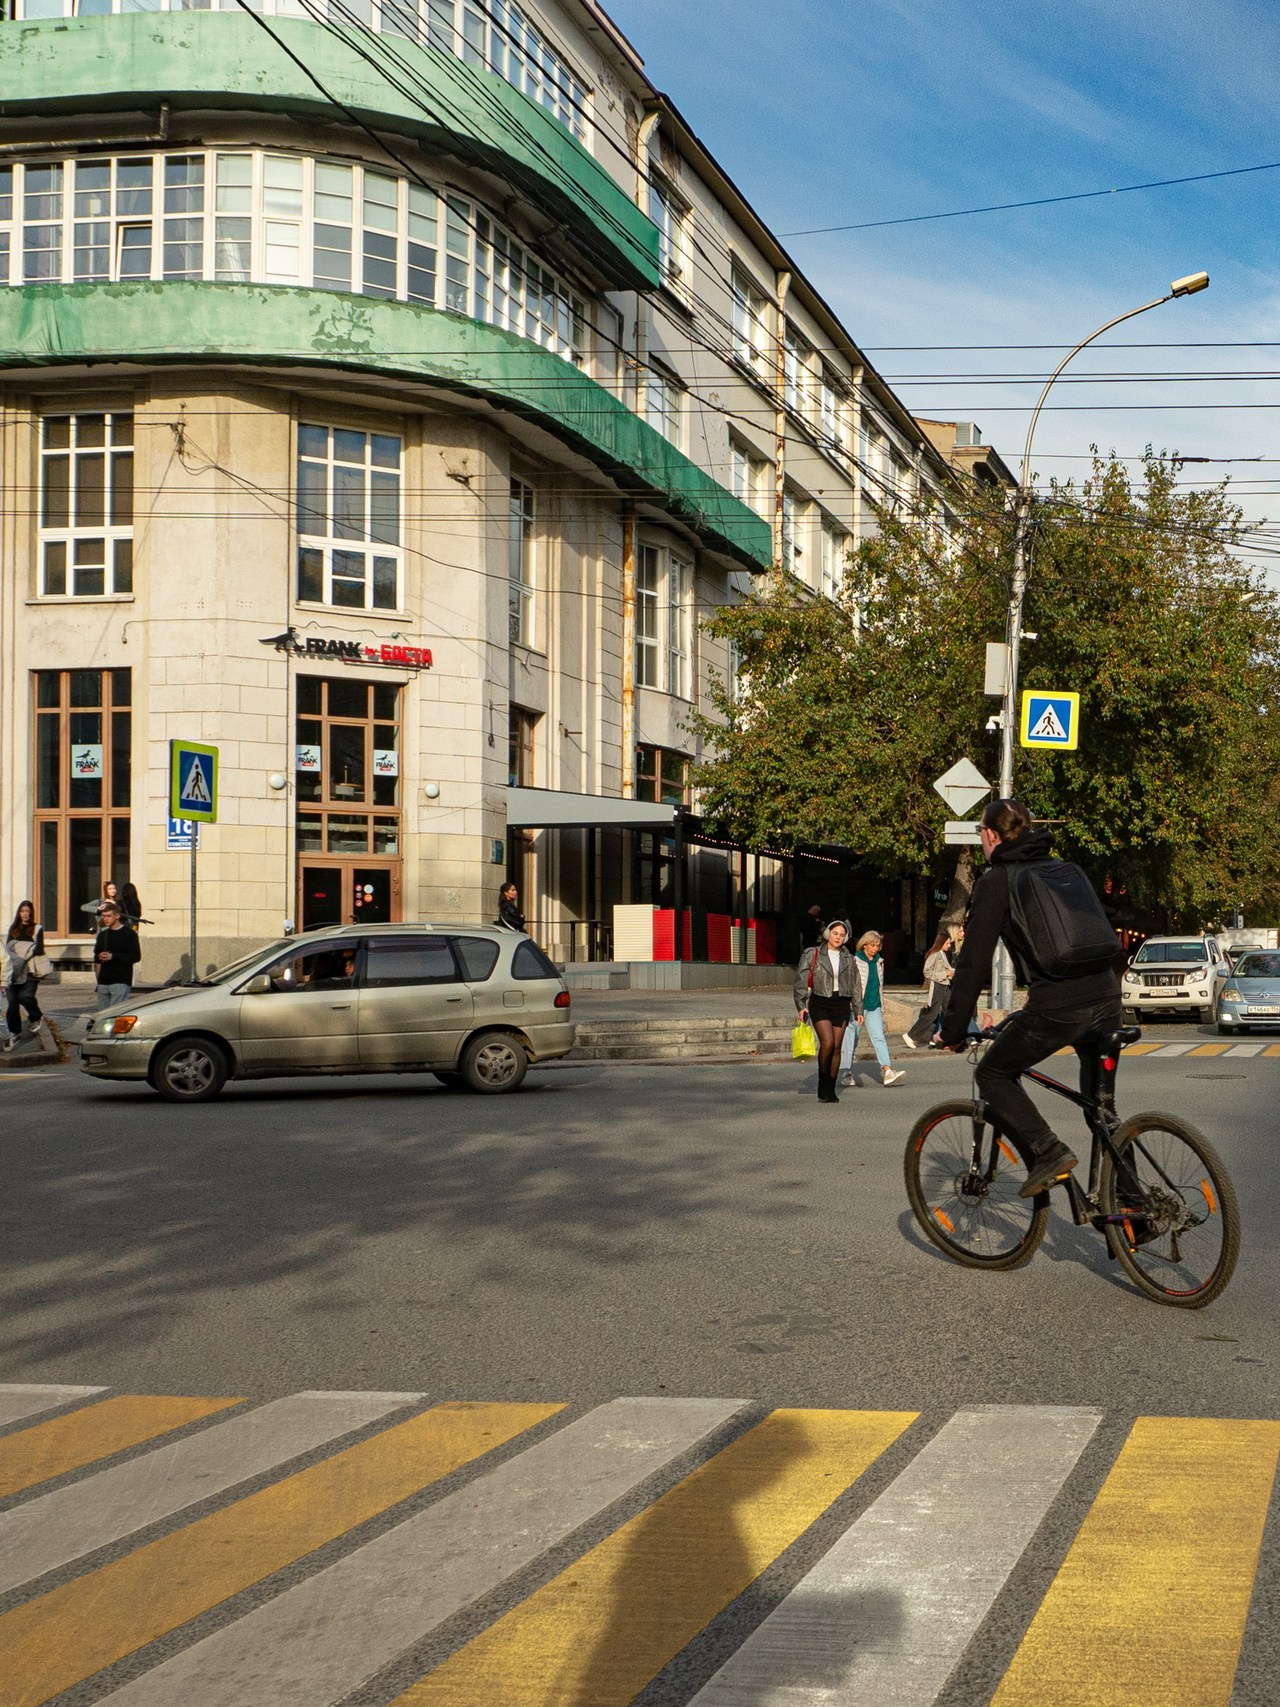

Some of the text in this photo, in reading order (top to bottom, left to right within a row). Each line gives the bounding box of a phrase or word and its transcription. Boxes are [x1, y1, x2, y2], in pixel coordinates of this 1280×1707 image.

[306, 637, 433, 667] FRANK by БАСТА
[75, 760, 99, 768] FRANK
